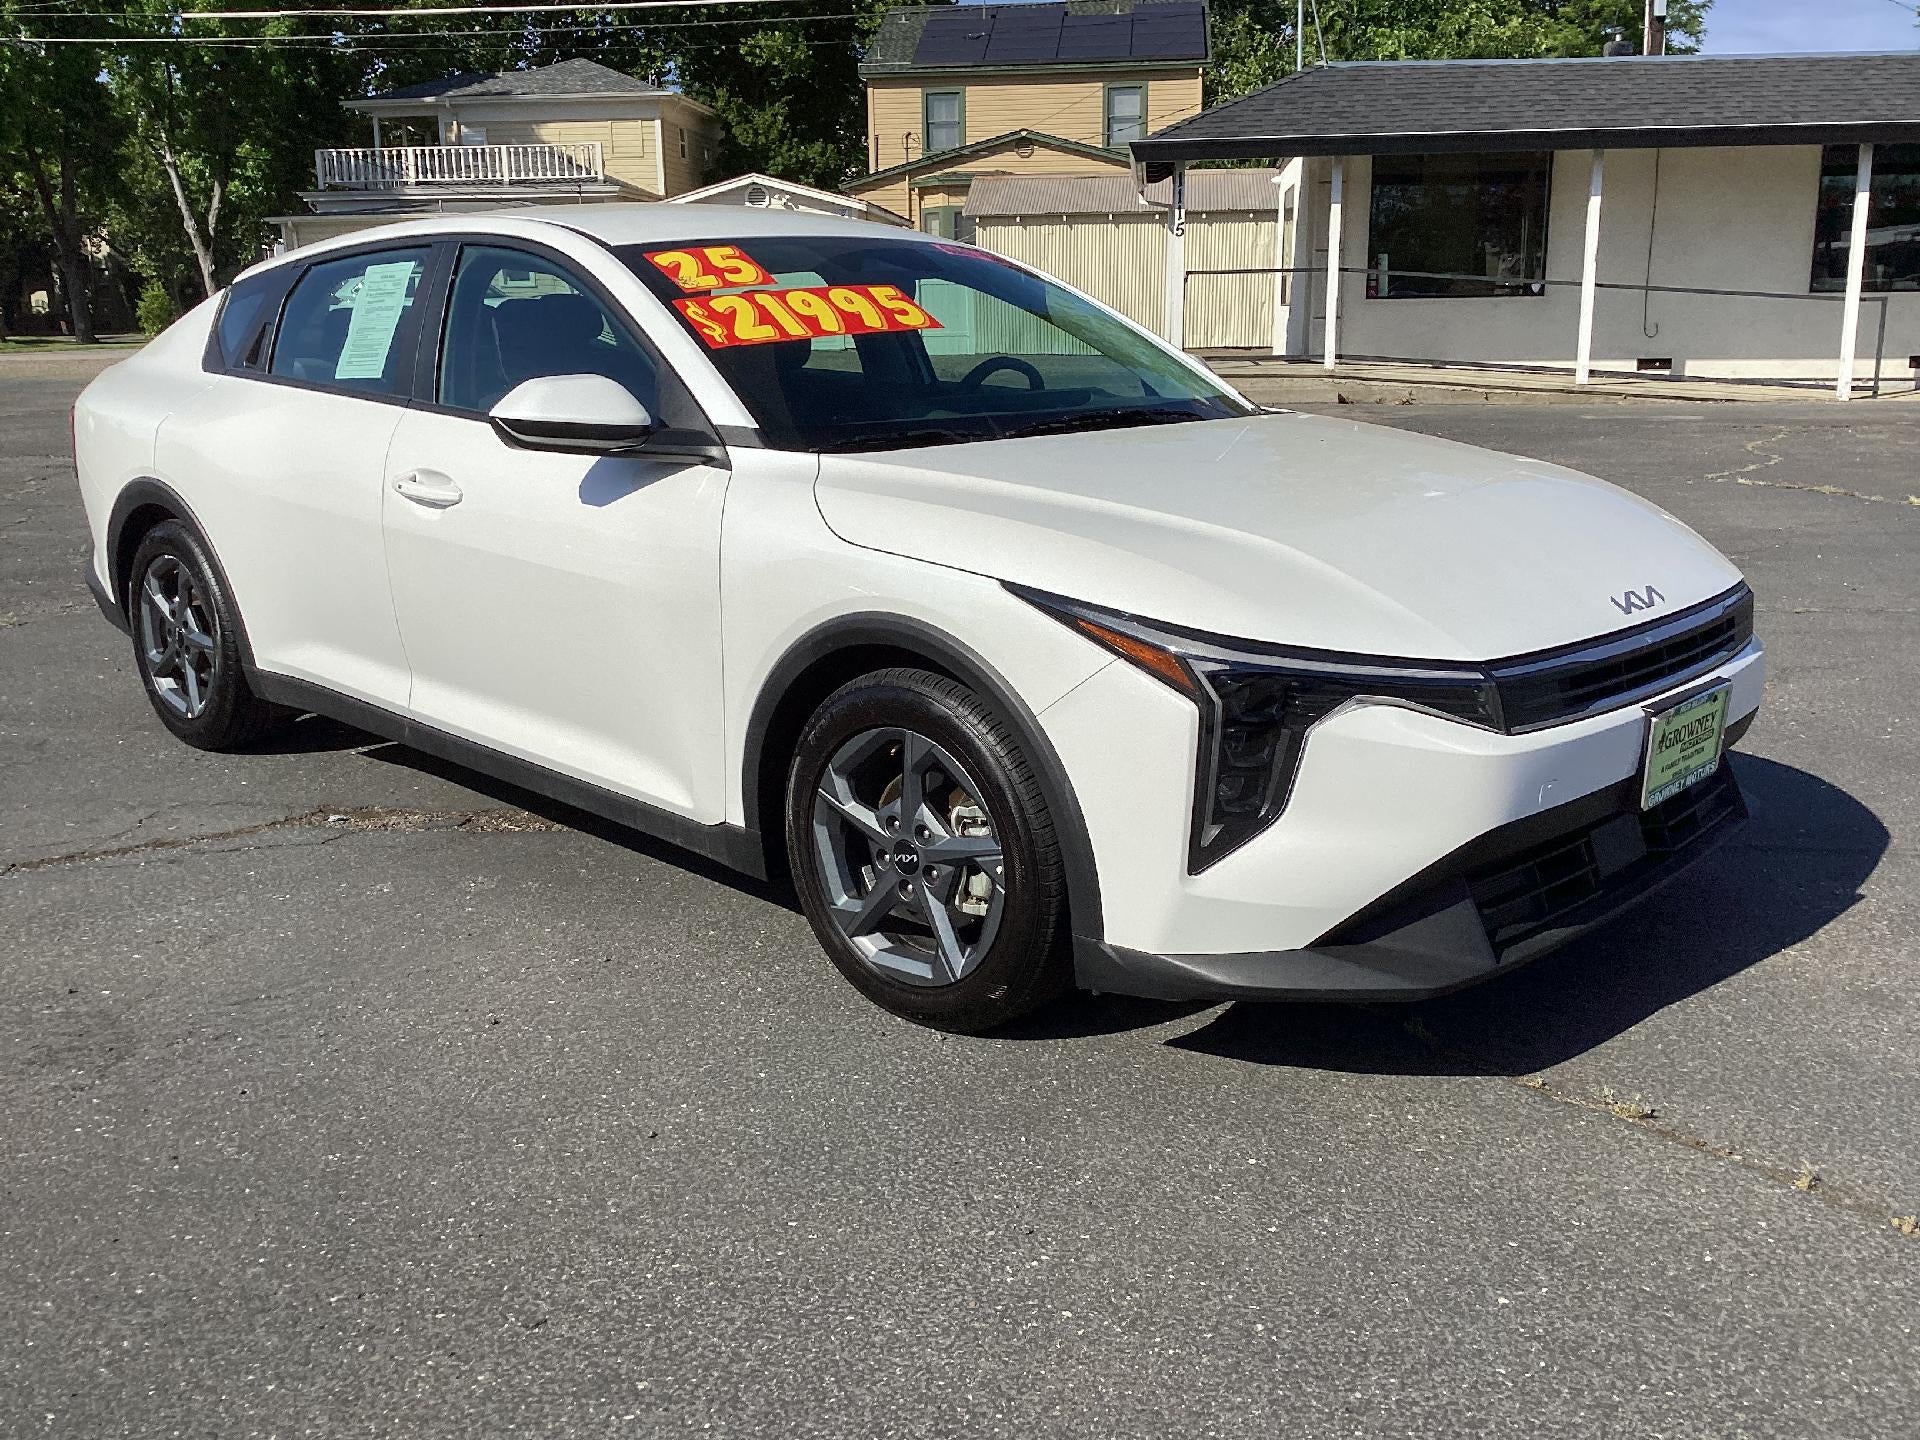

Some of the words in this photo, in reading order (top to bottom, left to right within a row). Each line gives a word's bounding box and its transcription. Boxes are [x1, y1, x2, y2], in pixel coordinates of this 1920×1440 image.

[1175, 172, 1185, 237] 1115
[653, 247, 763, 288] 25
[686, 286, 930, 345] $21995
[1664, 710, 1718, 750] GROWNEY
